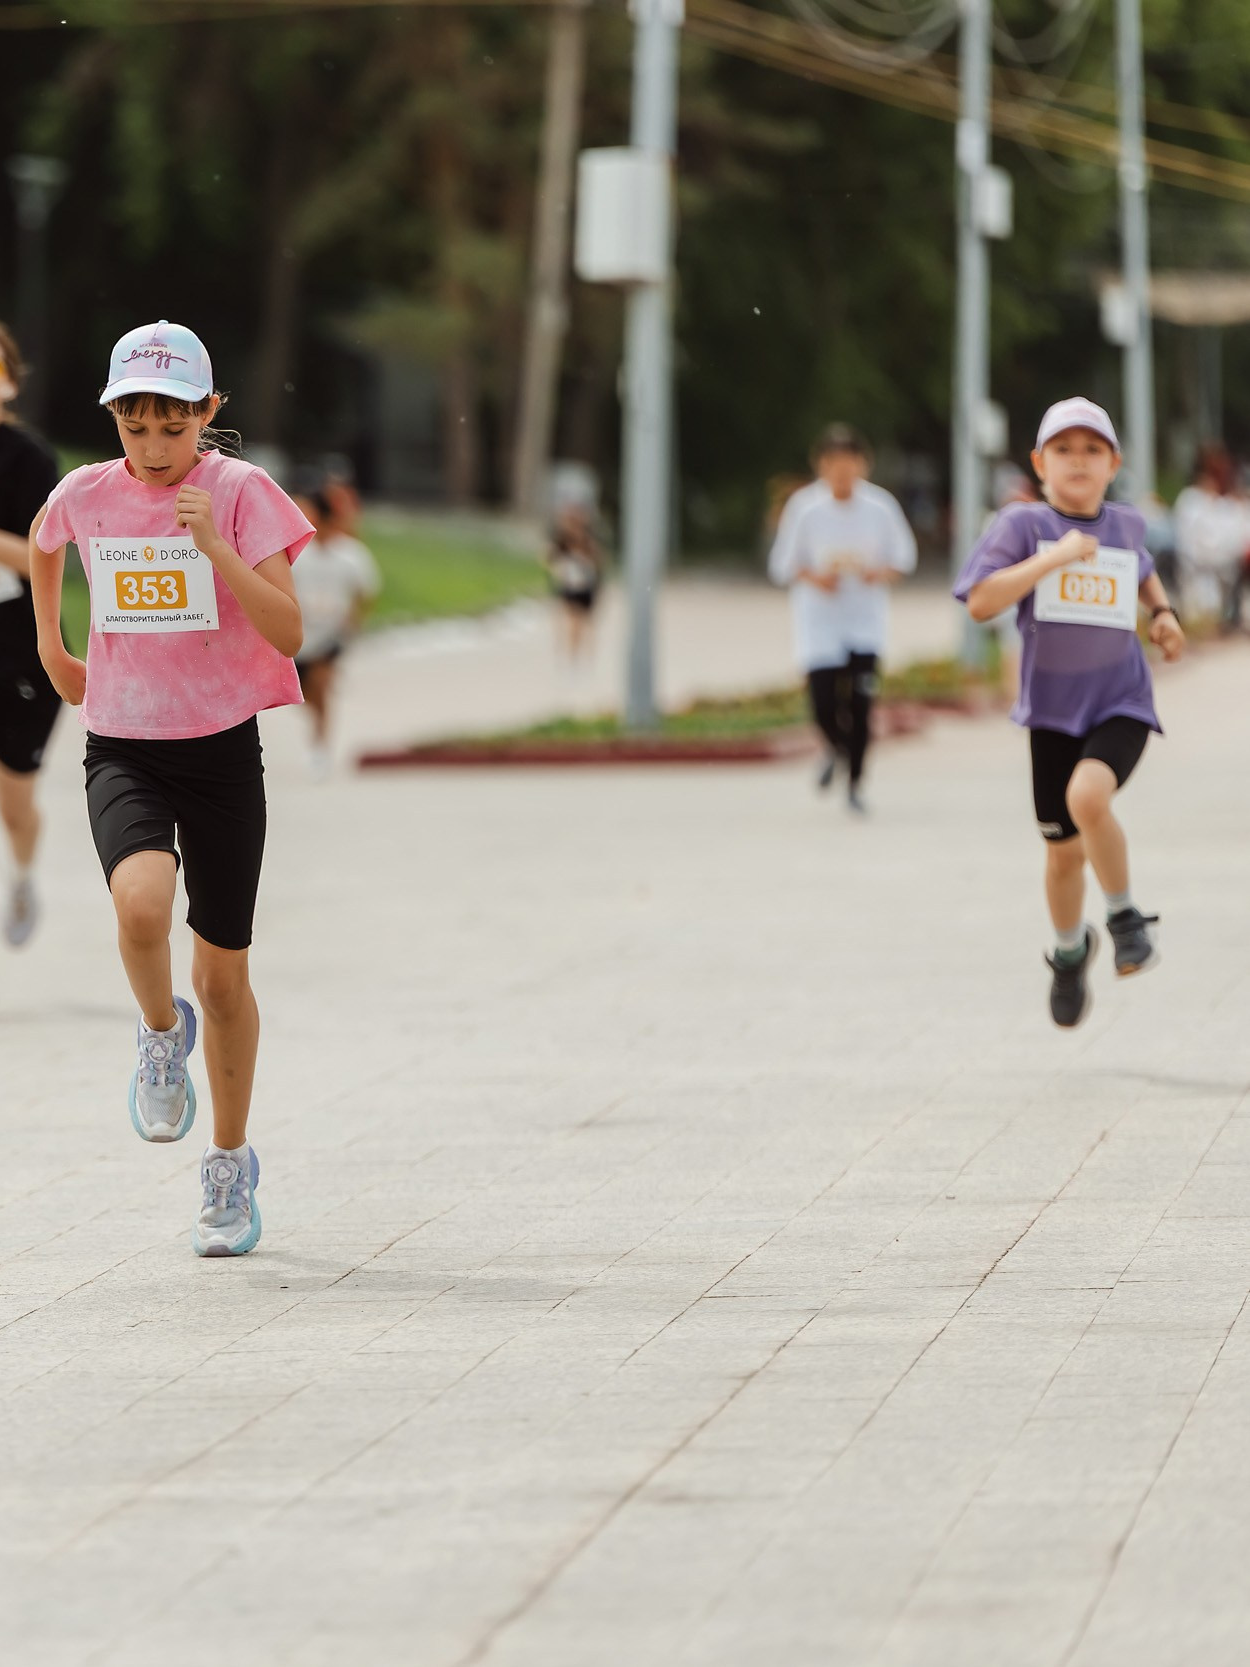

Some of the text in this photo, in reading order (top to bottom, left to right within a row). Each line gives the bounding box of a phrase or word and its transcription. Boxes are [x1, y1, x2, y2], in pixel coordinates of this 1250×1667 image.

[121, 349, 188, 369] energy
[99, 548, 199, 561] LEONE D'ORO
[122, 575, 179, 605] 353
[1066, 574, 1112, 605] 099
[105, 613, 205, 623] БЛАГОТВОРИТЕЛЬНЫЙ ЗАБЕГ
